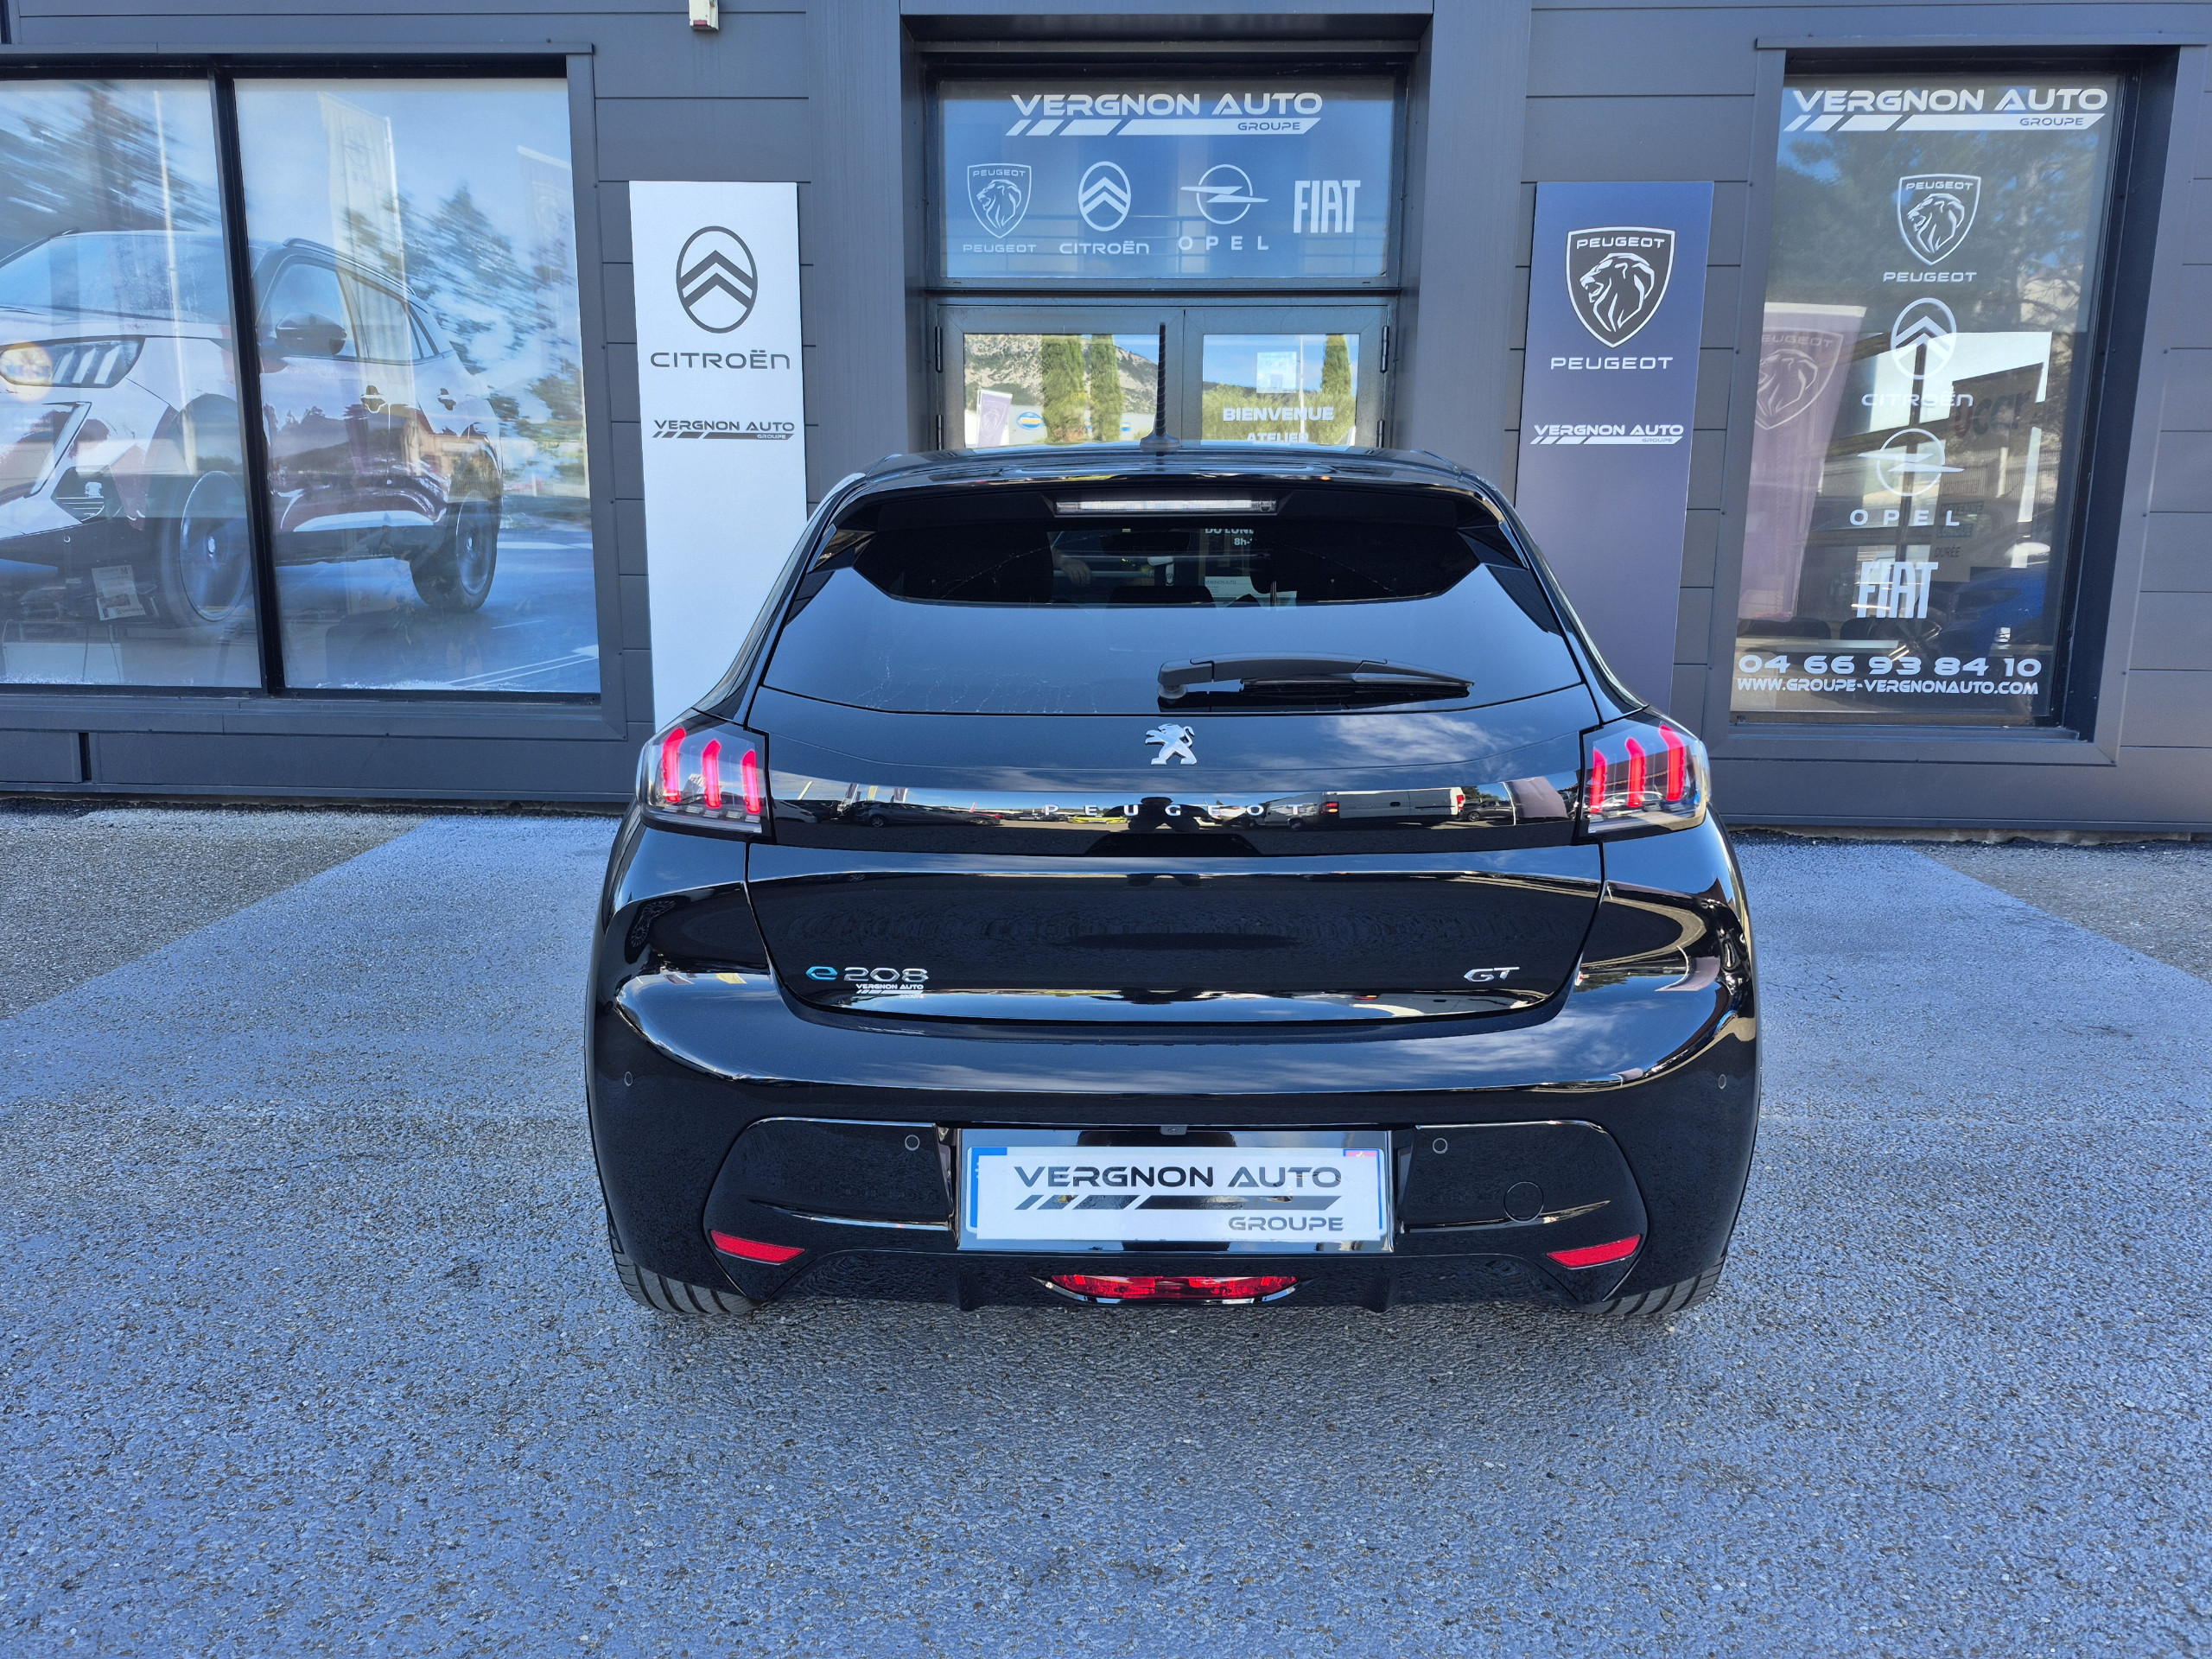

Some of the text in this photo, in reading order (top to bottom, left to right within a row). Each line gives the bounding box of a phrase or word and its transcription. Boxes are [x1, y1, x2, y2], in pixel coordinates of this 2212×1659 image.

[1010, 92, 1323, 117] VERGNON AUTO
[1793, 88, 2108, 112] VERGNON AUTO
[1237, 121, 1301, 131] GROUPE
[2019, 118, 2084, 127] GROUPE
[972, 168, 1027, 178] PEUGEOT
[1905, 181, 1974, 192] PEUGEOT
[1294, 180, 1361, 234] FIAT
[963, 244, 1037, 254] PEUGEOT
[1178, 235, 1269, 251] OPEL
[1576, 237, 1665, 250] PEUGEOT
[1882, 271, 1977, 283] PEUGEOT
[1761, 334, 1834, 347] EUGEOT
[1550, 357, 1674, 370] PEUGEOT
[1223, 406, 1334, 422] BIENVENUE
[654, 420, 795, 432] VERGNON AUTO
[1534, 424, 1684, 435] VERGNON AUTO
[1849, 509, 1961, 526] OPEL
[1856, 561, 1939, 619] FIAT
[1738, 654, 2042, 677] 04 66 93 84 10
[1737, 677, 2039, 695] WWW.GROUPE-VERGNONAUTO.COM
[1045, 804, 1306, 817] PEUGEOT
[1464, 966, 1520, 982] GT
[1014, 1166, 1343, 1189] VERGNON AUTO
[1228, 1216, 1344, 1232] GROUPE
